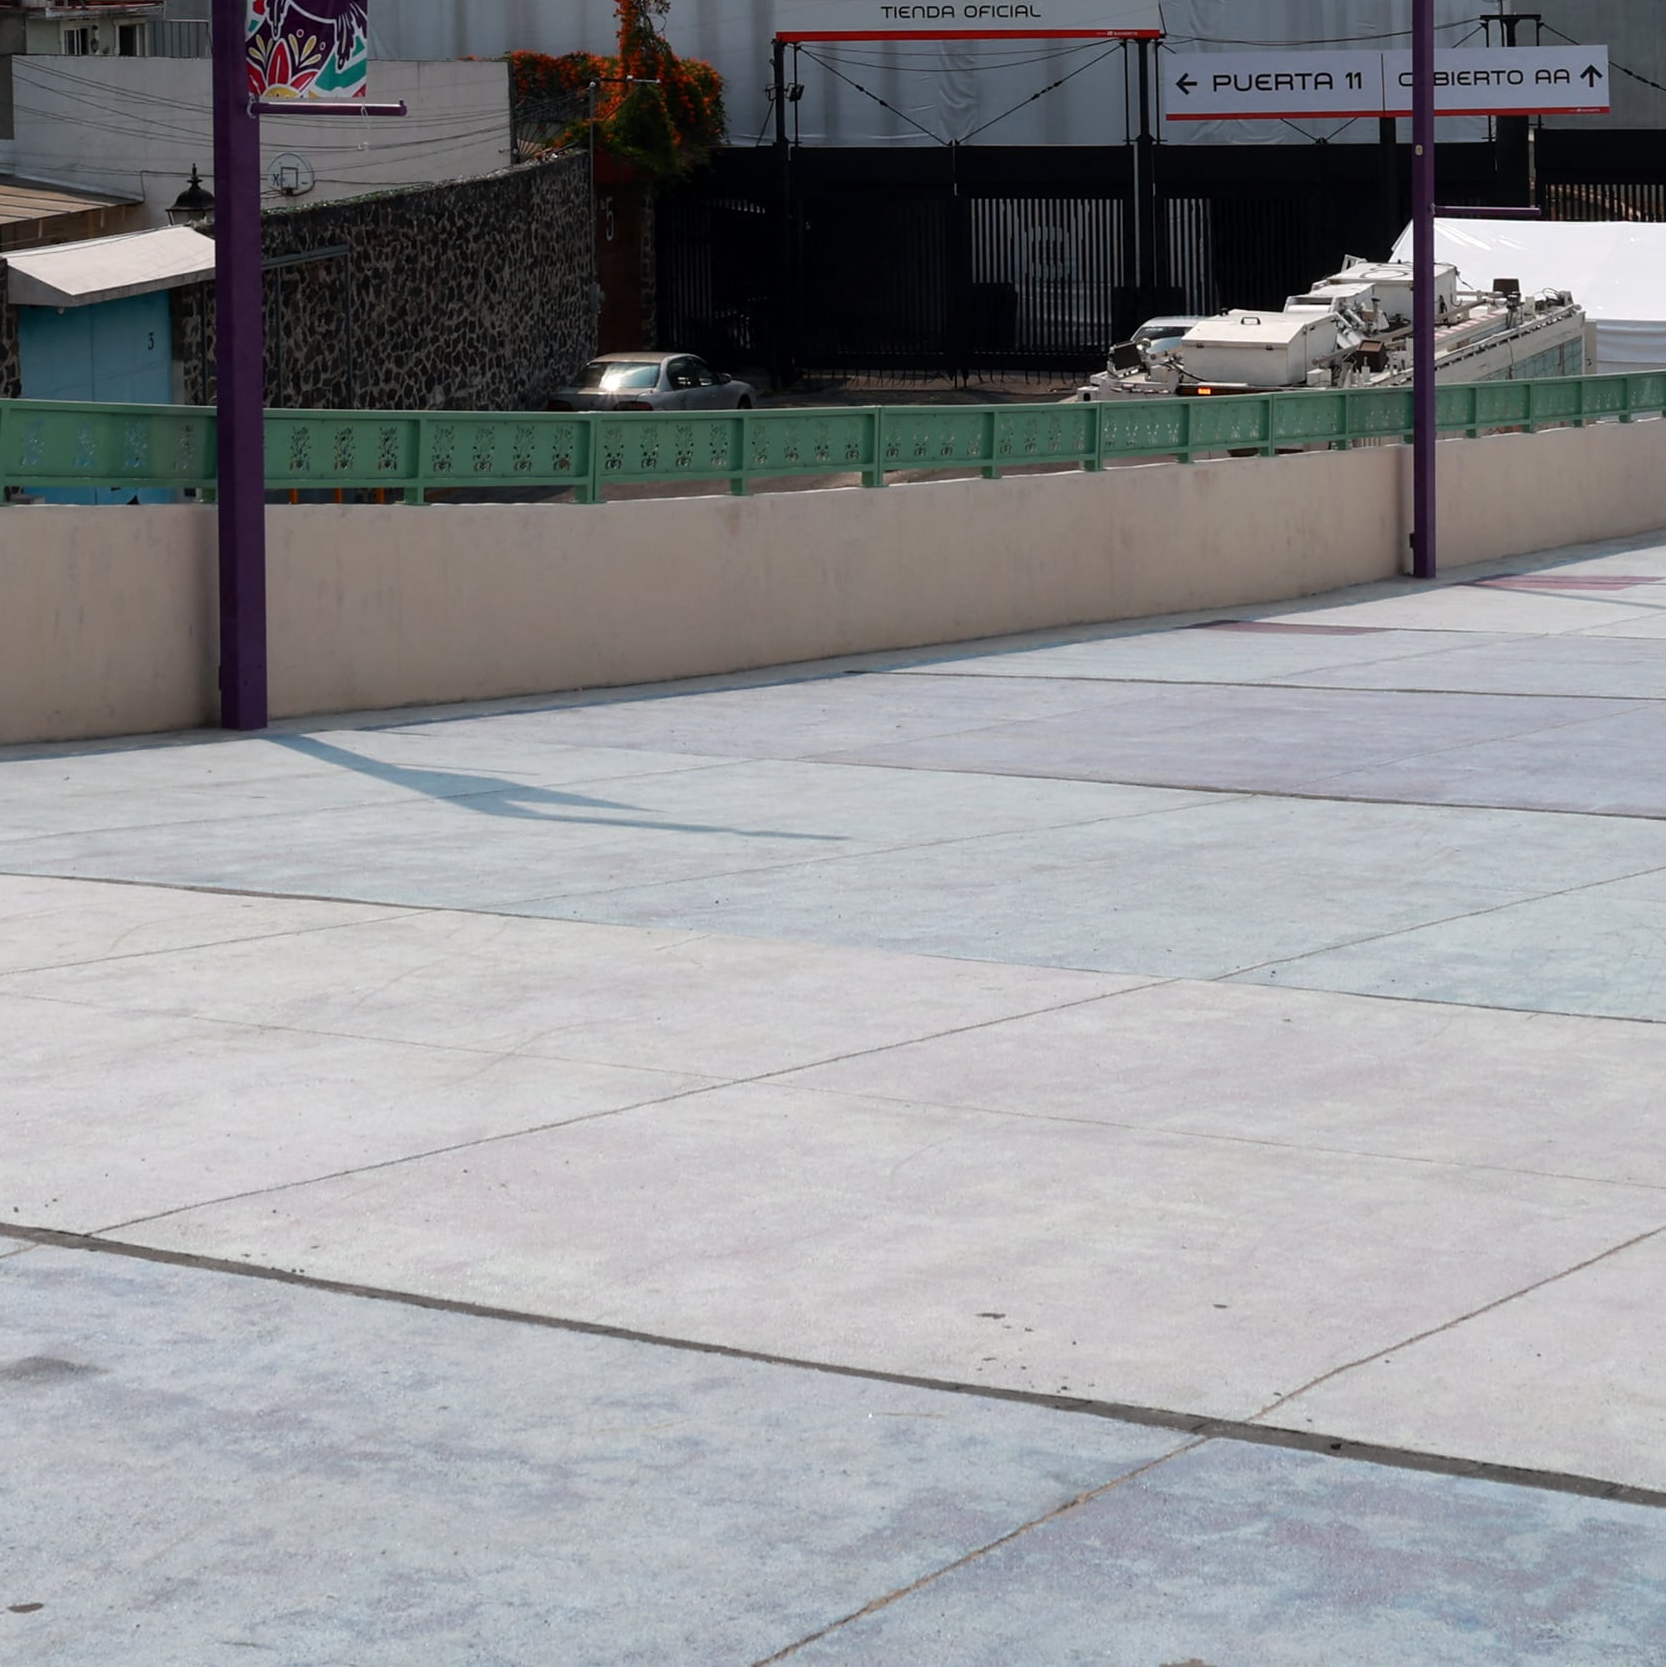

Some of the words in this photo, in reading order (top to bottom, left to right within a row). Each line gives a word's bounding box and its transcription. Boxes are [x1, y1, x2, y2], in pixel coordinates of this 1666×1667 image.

[881, 5, 955, 19] TIENDA
[964, 4, 1042, 18] OFICIAL
[1213, 72, 1334, 92] PUERTA
[1345, 72, 1362, 90] 11
[1398, 70, 1524, 87] CBIERTO
[1535, 69, 1570, 84] AA
